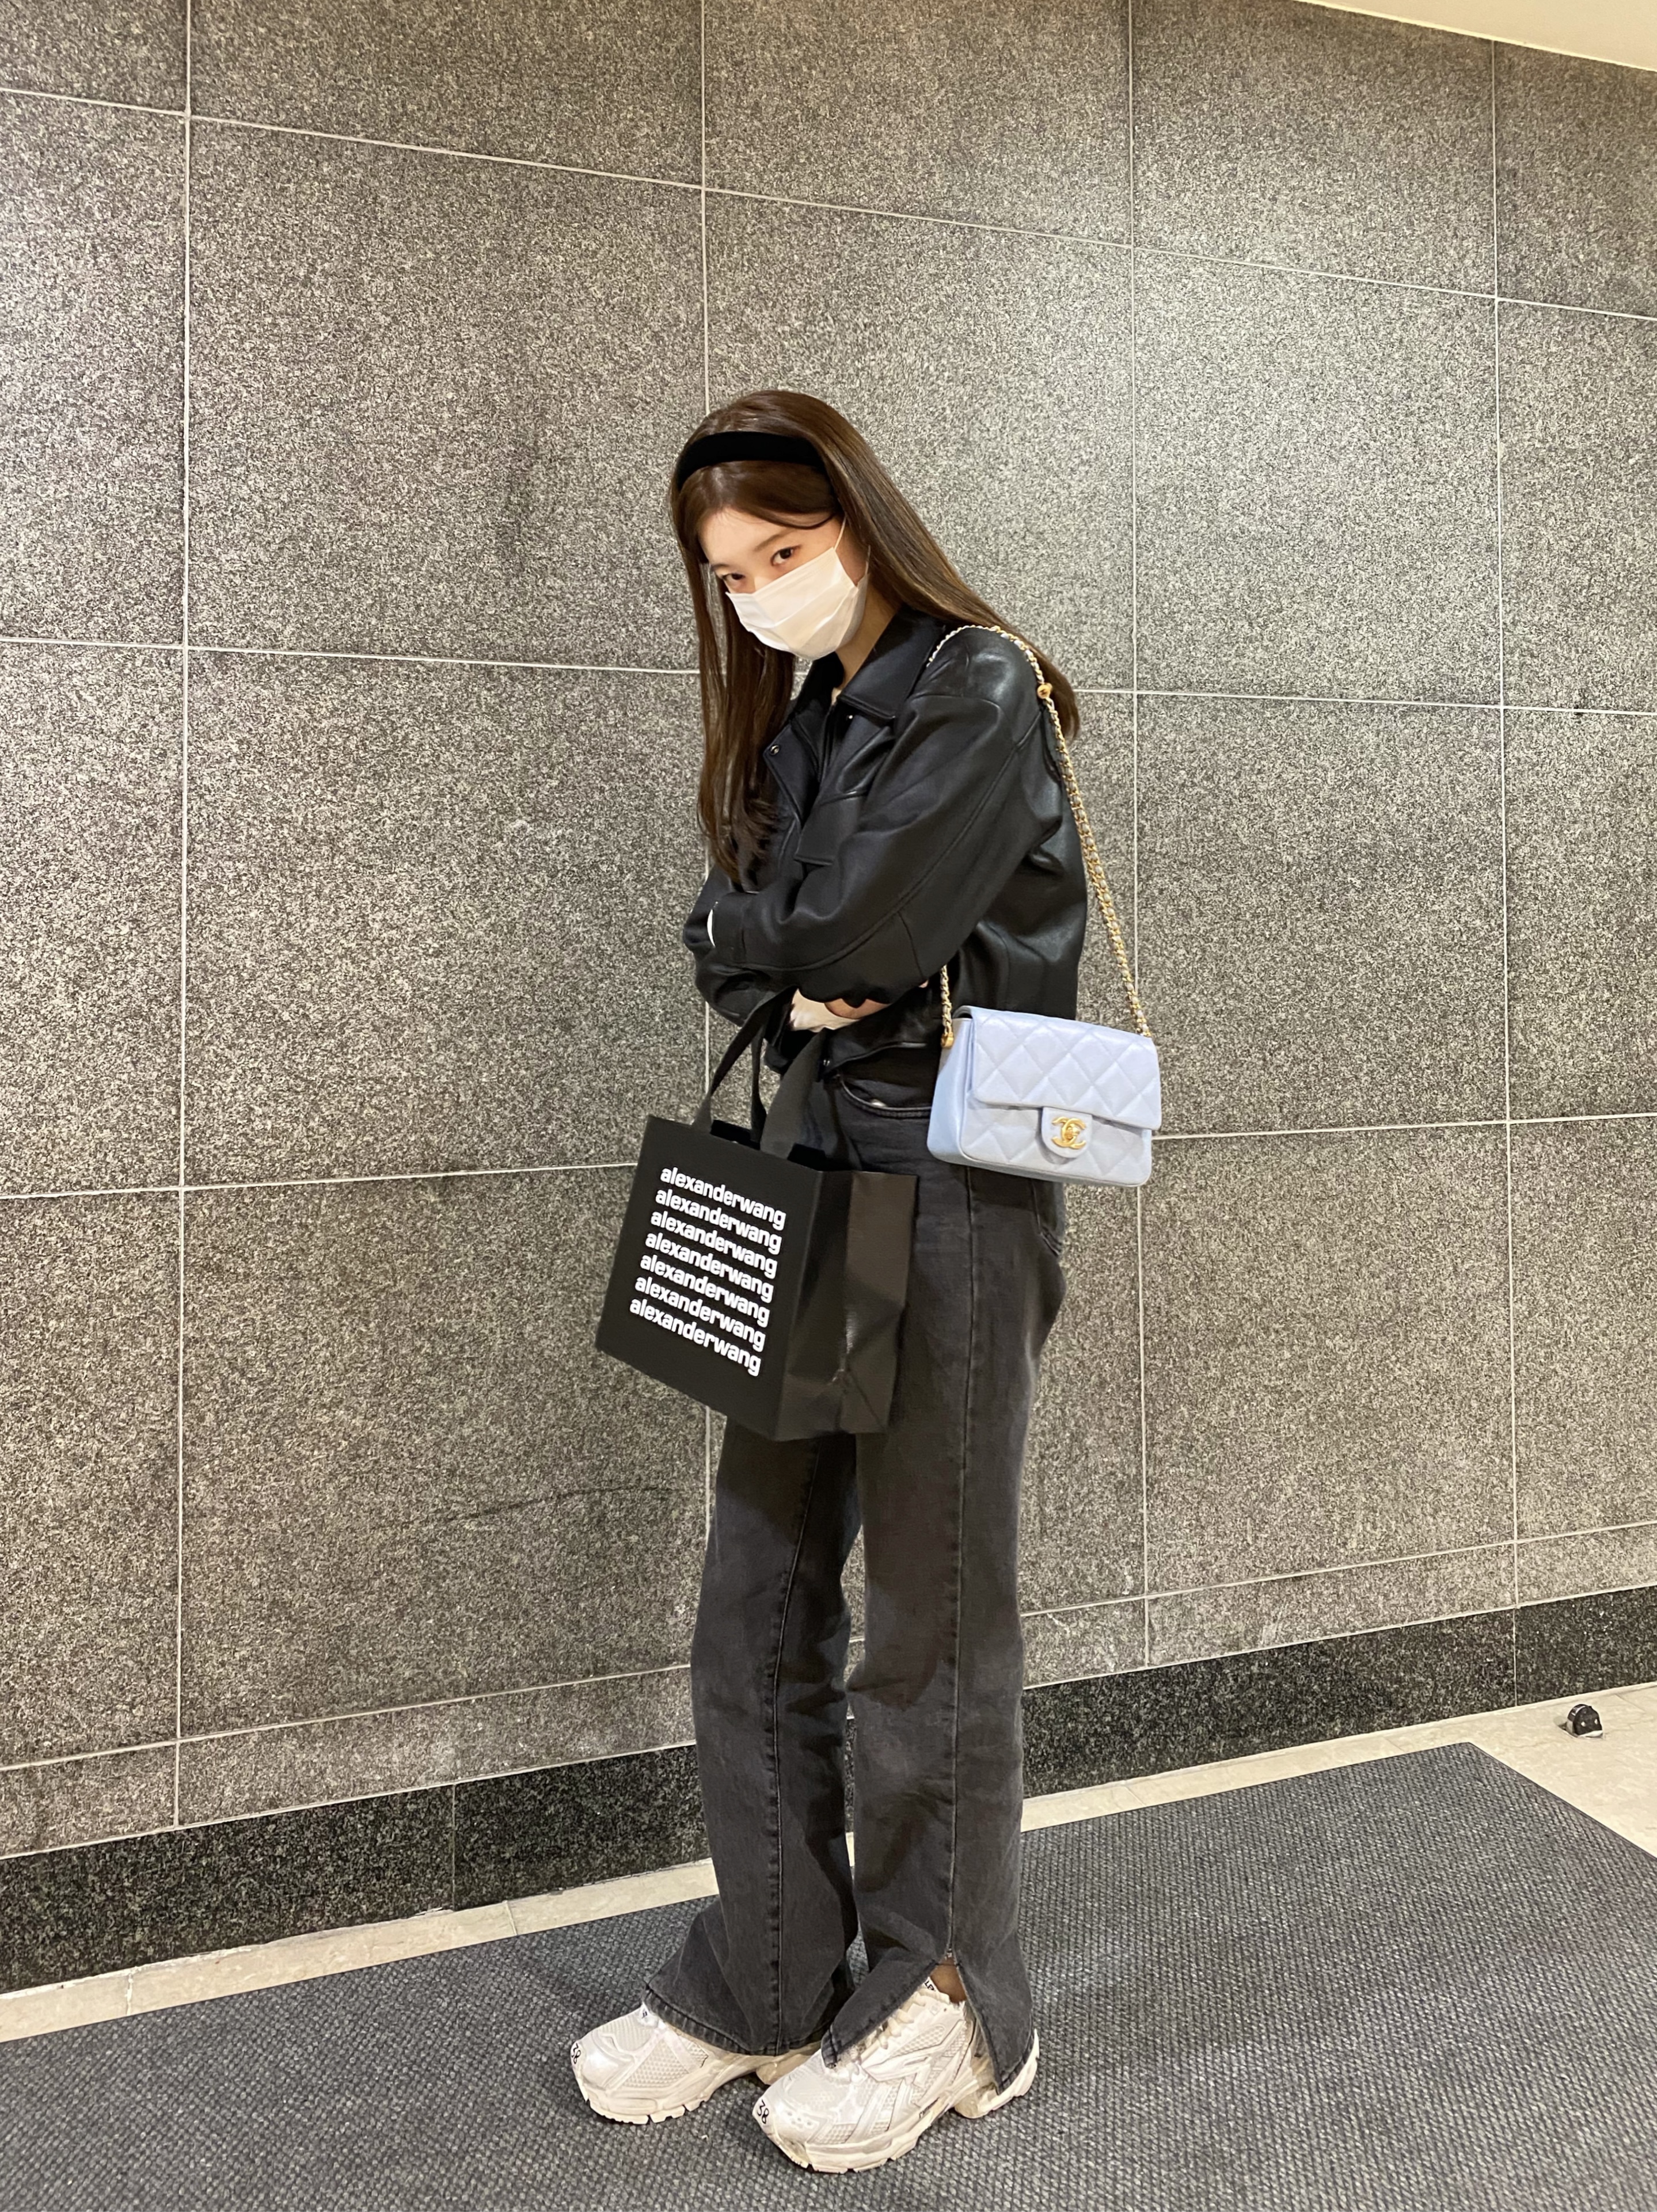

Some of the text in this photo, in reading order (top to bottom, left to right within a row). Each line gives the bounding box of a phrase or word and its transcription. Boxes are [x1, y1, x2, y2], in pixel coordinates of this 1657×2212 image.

[655, 1189, 782, 1255] alexanderwang
[660, 1167, 786, 1231] alexanderwang
[645, 1232, 774, 1304] alexanderwang
[650, 1210, 778, 1280] alexanderwang
[634, 1276, 766, 1353] alexanderwang
[640, 1254, 770, 1328] alexanderwang
[629, 1299, 762, 1377] alexanderwang
[756, 2098, 770, 2125] 38
